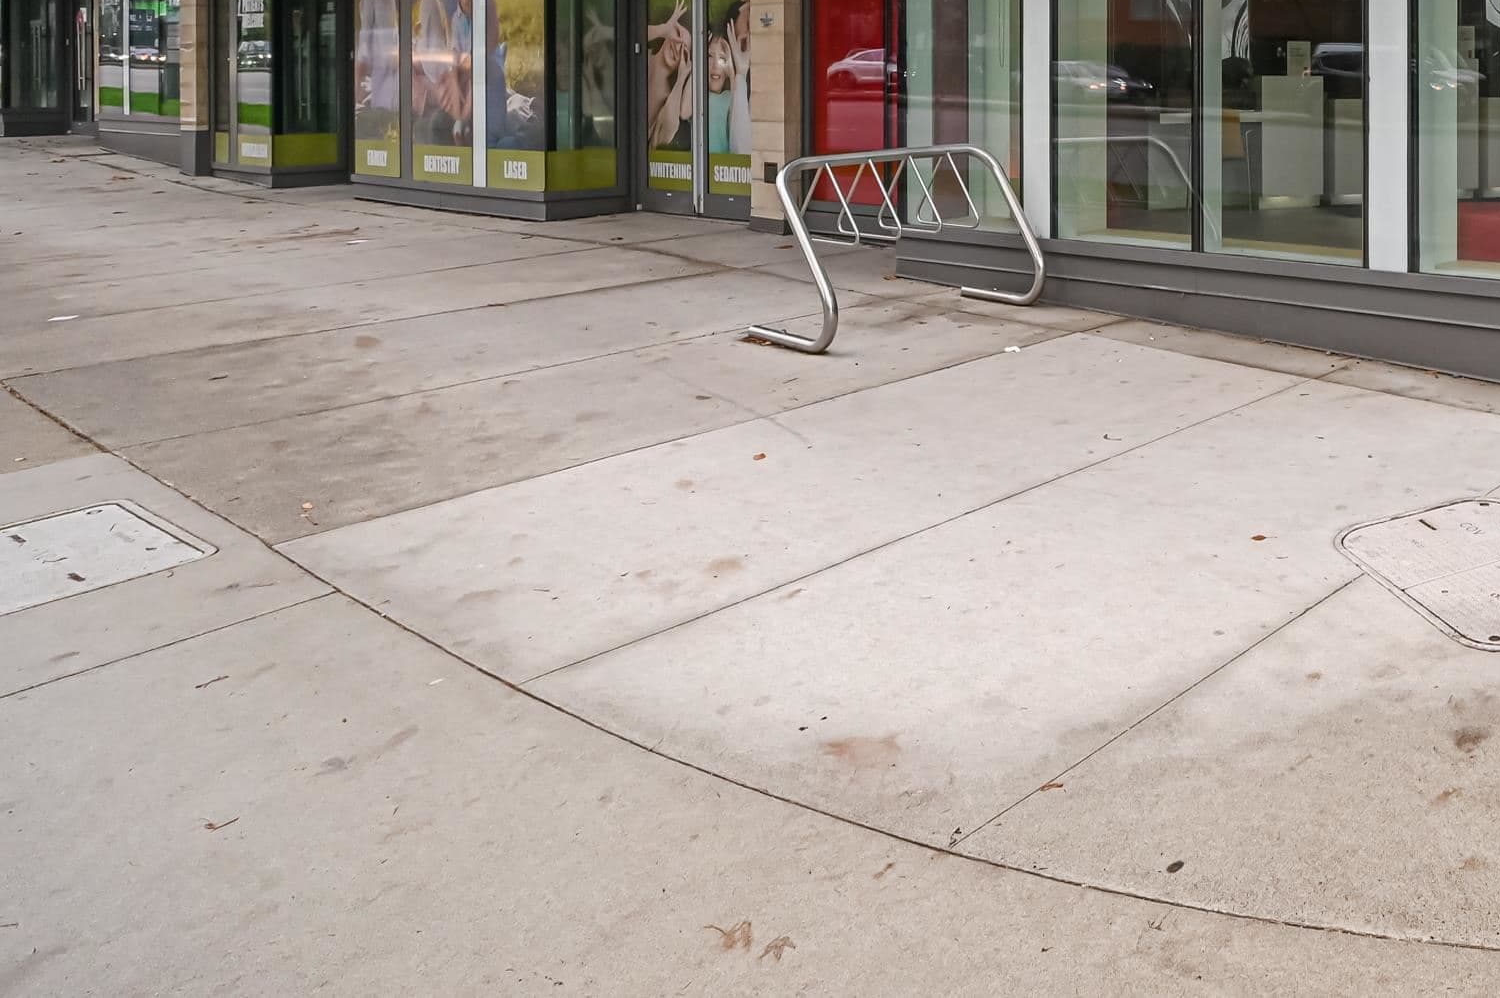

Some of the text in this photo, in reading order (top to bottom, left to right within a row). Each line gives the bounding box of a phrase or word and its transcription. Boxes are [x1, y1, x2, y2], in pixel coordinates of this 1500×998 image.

[424, 155, 460, 175] DENTISTRY
[504, 160, 528, 180] LASER
[649, 161, 692, 180] WHITENING
